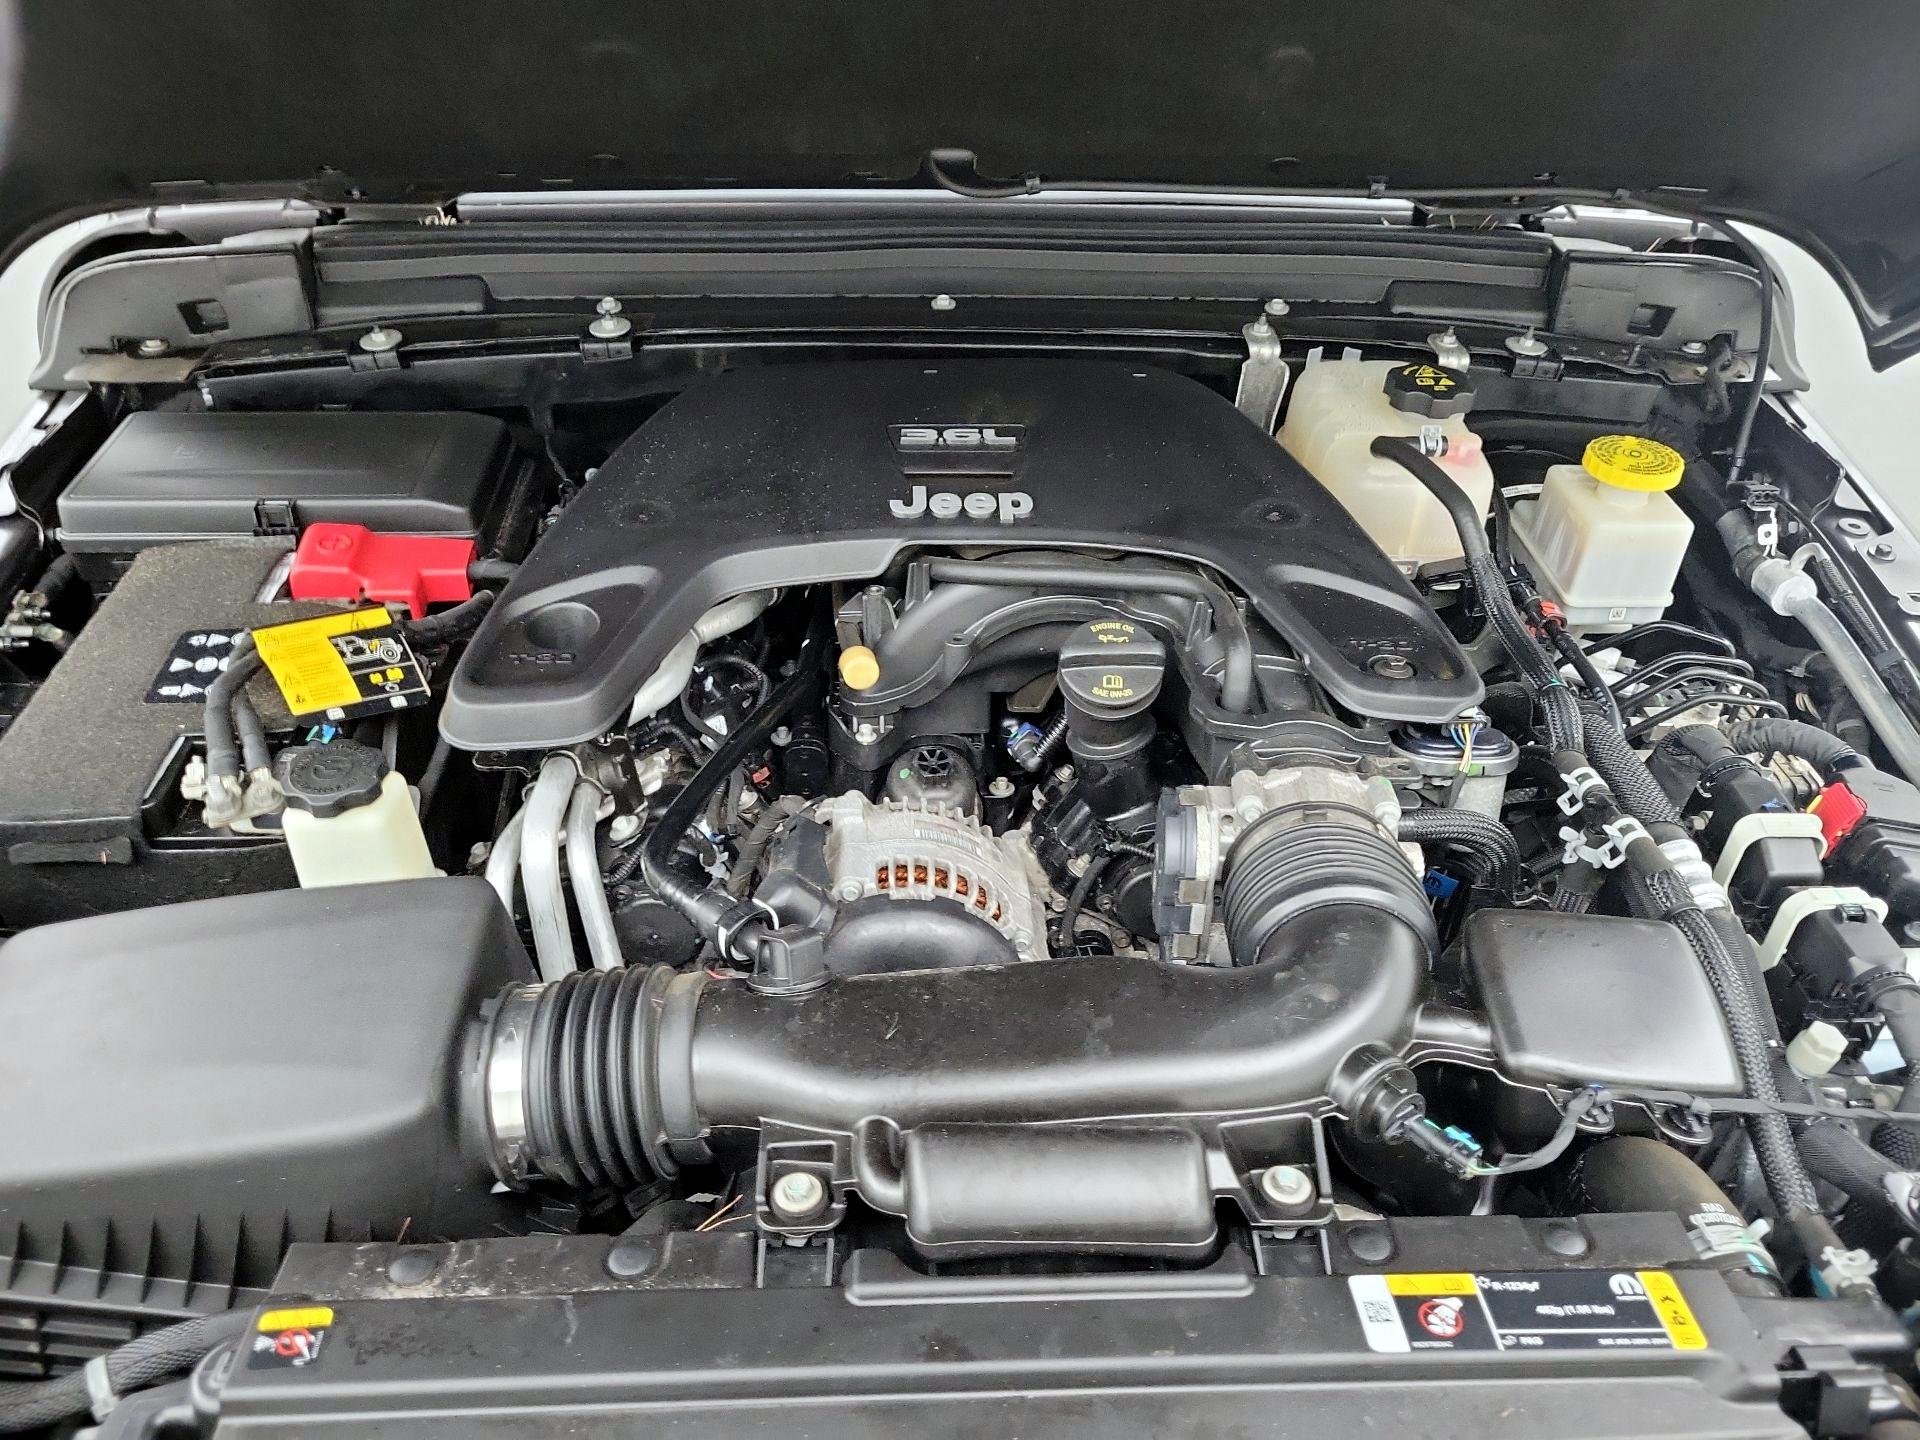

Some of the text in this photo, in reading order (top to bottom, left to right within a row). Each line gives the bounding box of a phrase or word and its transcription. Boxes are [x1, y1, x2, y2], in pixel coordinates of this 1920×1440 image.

[900, 428, 1017, 445] 3.6L
[889, 485, 1034, 523] Jeep
[1089, 622, 1135, 634] ENGINE OIL
[1091, 686, 1109, 698] SAE
